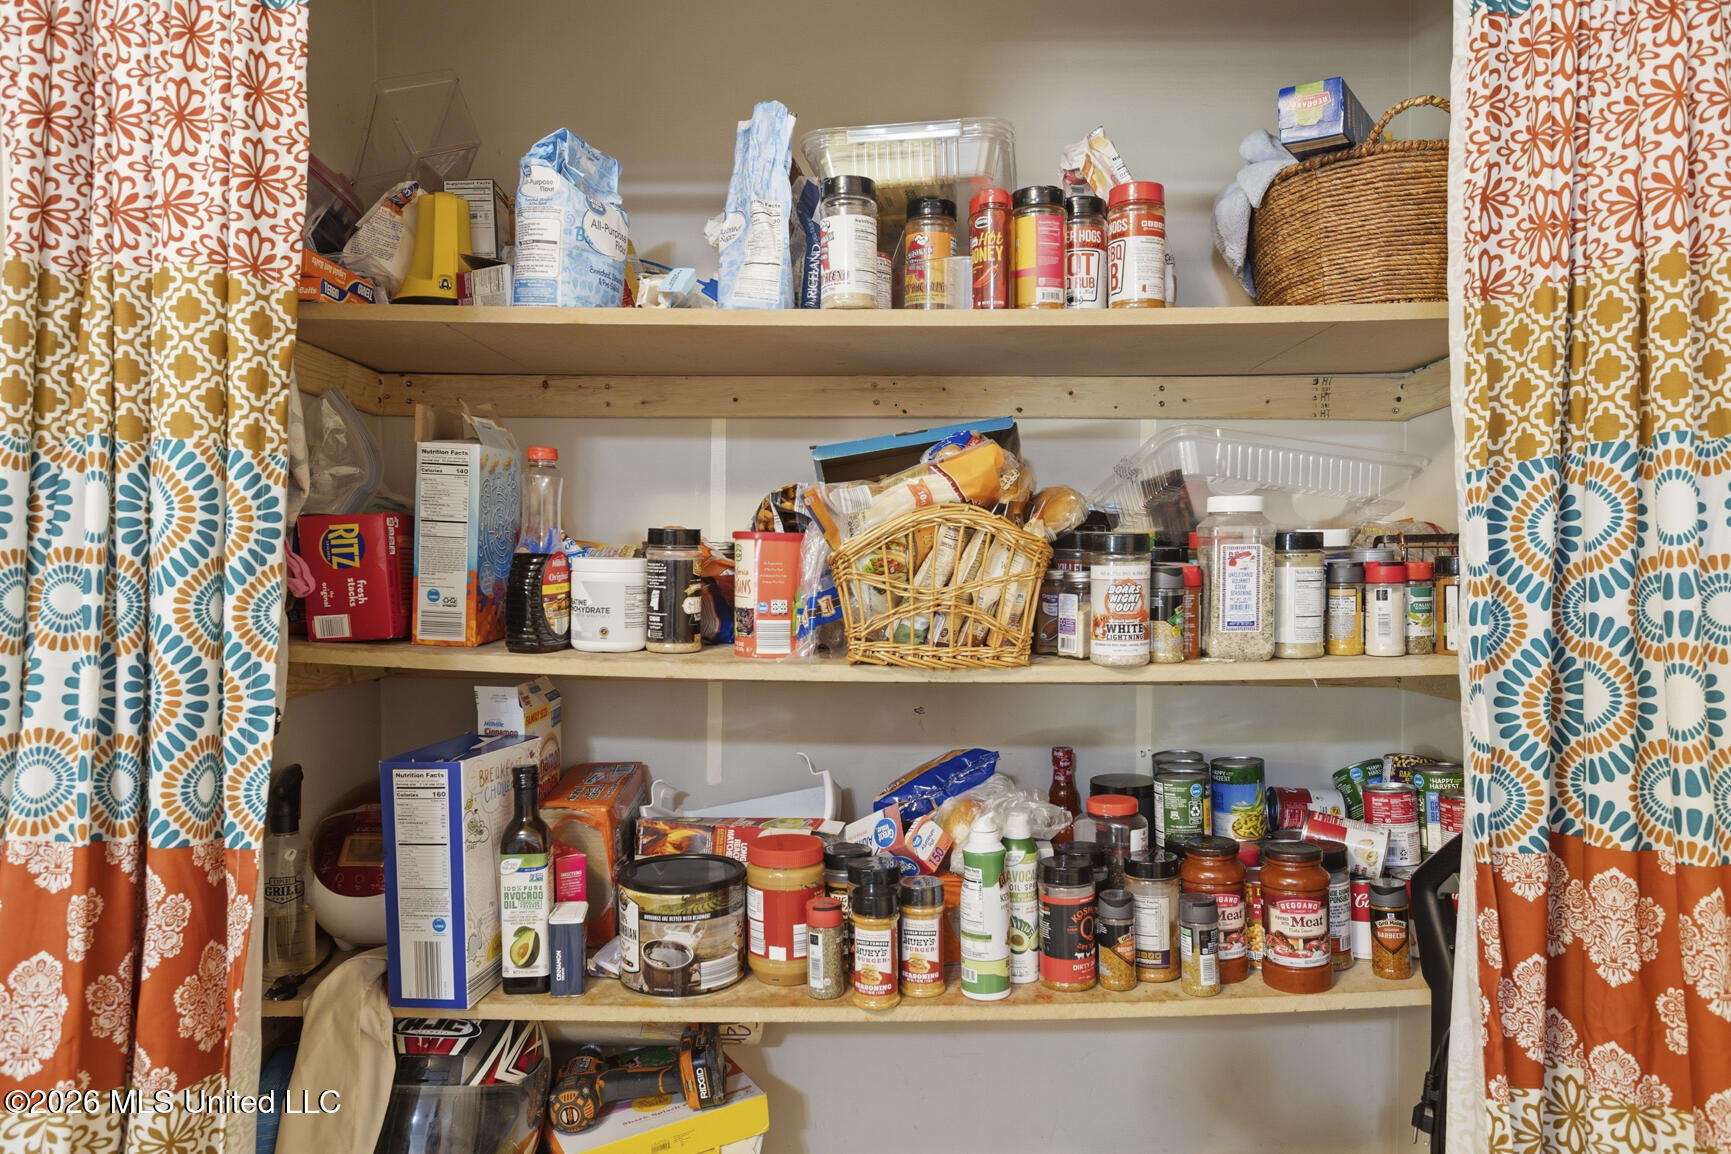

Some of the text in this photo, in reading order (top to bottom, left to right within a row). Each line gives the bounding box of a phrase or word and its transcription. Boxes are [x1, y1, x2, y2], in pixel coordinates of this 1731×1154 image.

[590, 218, 627, 245] All-Purpose
[1078, 229, 1102, 243] HOGS
[978, 231, 1004, 247] Hot
[971, 245, 1004, 265] ONEY
[1108, 244, 1122, 262] BQ
[1067, 252, 1095, 276] OT
[806, 244, 821, 299] RICELAND
[327, 523, 360, 570] RITZ
[320, 582, 331, 608] original
[347, 577, 358, 607] stacks
[356, 579, 368, 604] fresh
[1108, 584, 1142, 594] BOARS
[1109, 593, 1141, 603] NIGHT
[571, 605, 611, 615] OHYDRATE
[1115, 603, 1136, 612] OUT
[1106, 623, 1143, 634] WHITE
[1106, 633, 1143, 641] LIGHTNING
[484, 728, 519, 737] Cinnamon
[726, 829, 735, 858] MATCHE
[739, 842, 748, 862] LONG
[928, 846, 945, 867] 150
[504, 891, 544, 900] AVOCADO
[1216, 896, 1238, 904] GANO
[504, 900, 518, 909] OIL
[1290, 916, 1323, 928] Meat
[1072, 961, 1090, 972] DIRTY
[855, 981, 892, 991] SEASONING
[400, 1019, 468, 1033] HJC
[696, 1067, 708, 1099] RIDGID
